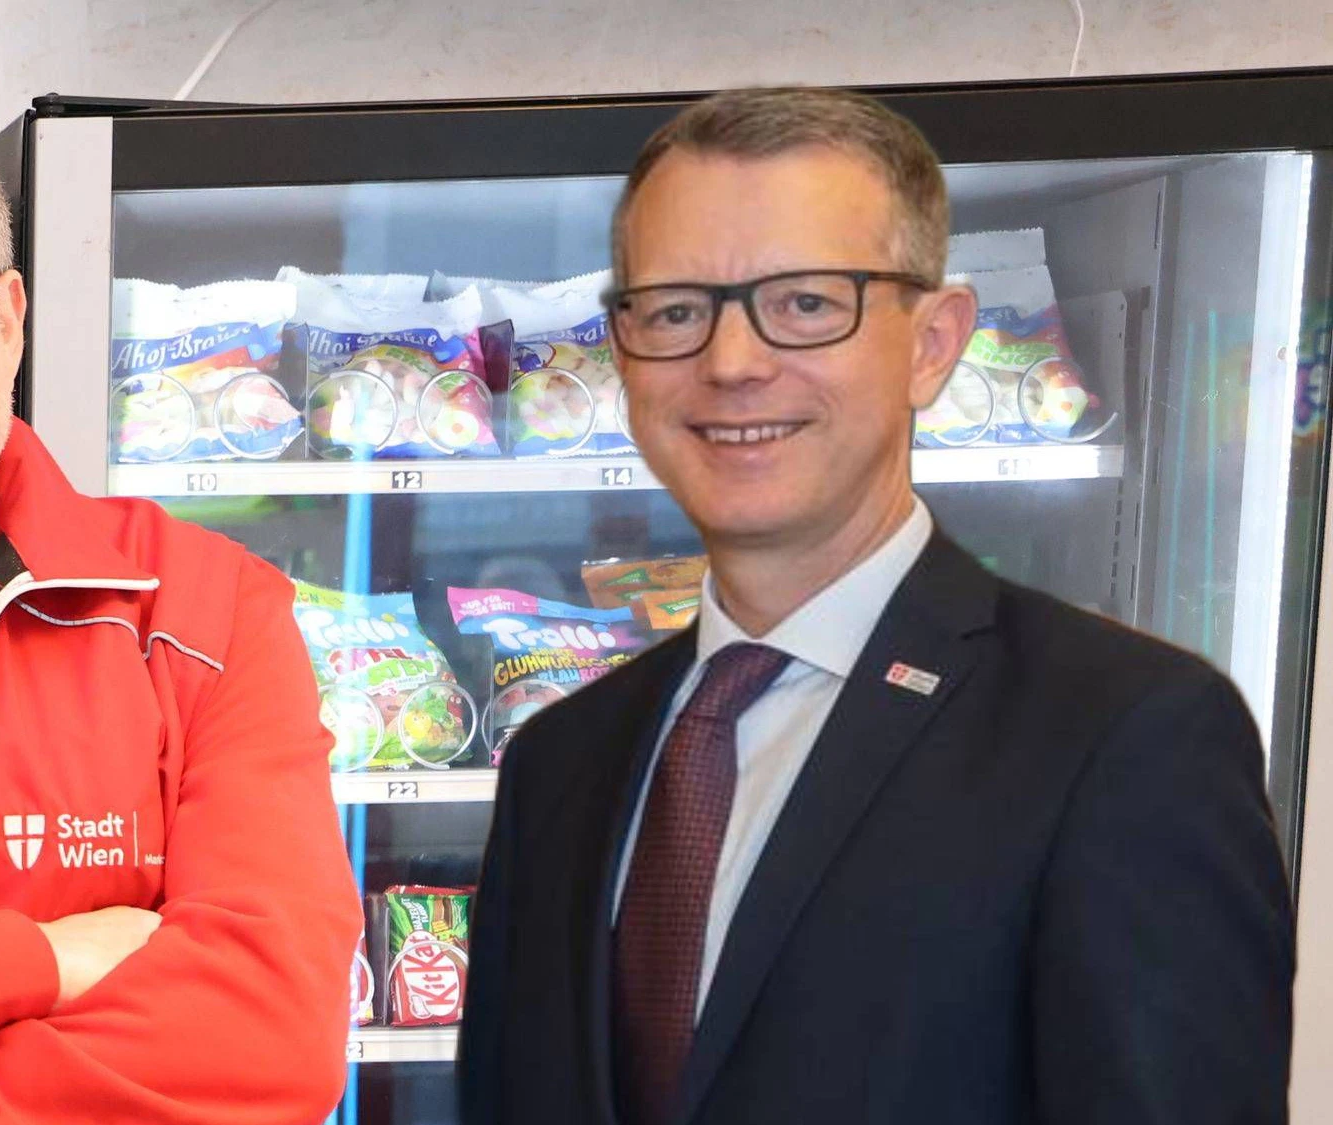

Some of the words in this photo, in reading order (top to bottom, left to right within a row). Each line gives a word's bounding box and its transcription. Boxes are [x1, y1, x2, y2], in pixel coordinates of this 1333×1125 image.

[189, 474, 216, 491] 10
[393, 471, 421, 488] 12
[604, 468, 631, 486] 14
[482, 617, 617, 651] Trolli
[390, 782, 418, 799] 22
[57, 811, 124, 839] Stadt
[57, 841, 124, 869] Wien
[403, 934, 457, 1007] KitKat
